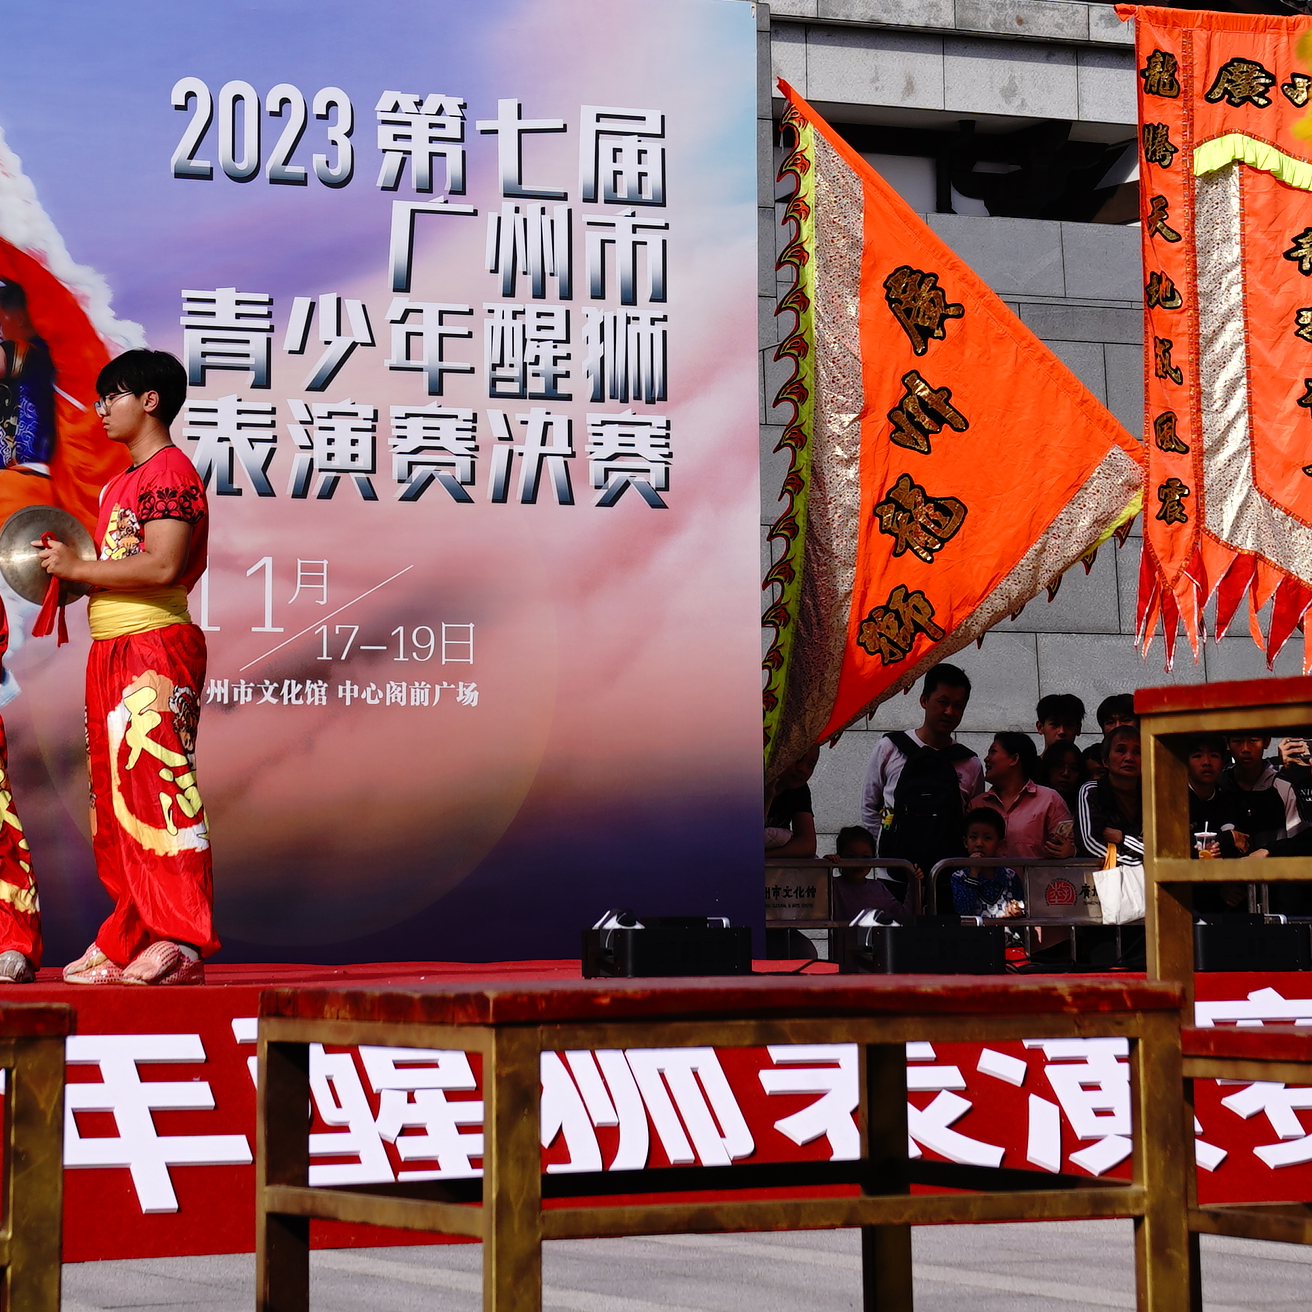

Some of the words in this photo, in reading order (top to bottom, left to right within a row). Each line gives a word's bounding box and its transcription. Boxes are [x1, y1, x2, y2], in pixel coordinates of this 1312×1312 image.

[170, 77, 668, 207] 2023第七届
[388, 196, 669, 304] 广州市
[179, 287, 668, 404] 青少年醒狮
[182, 394, 674, 509] 表演赛决赛
[206, 678, 328, 706] 州市文化馆
[338, 680, 480, 707] 中心阁前广场
